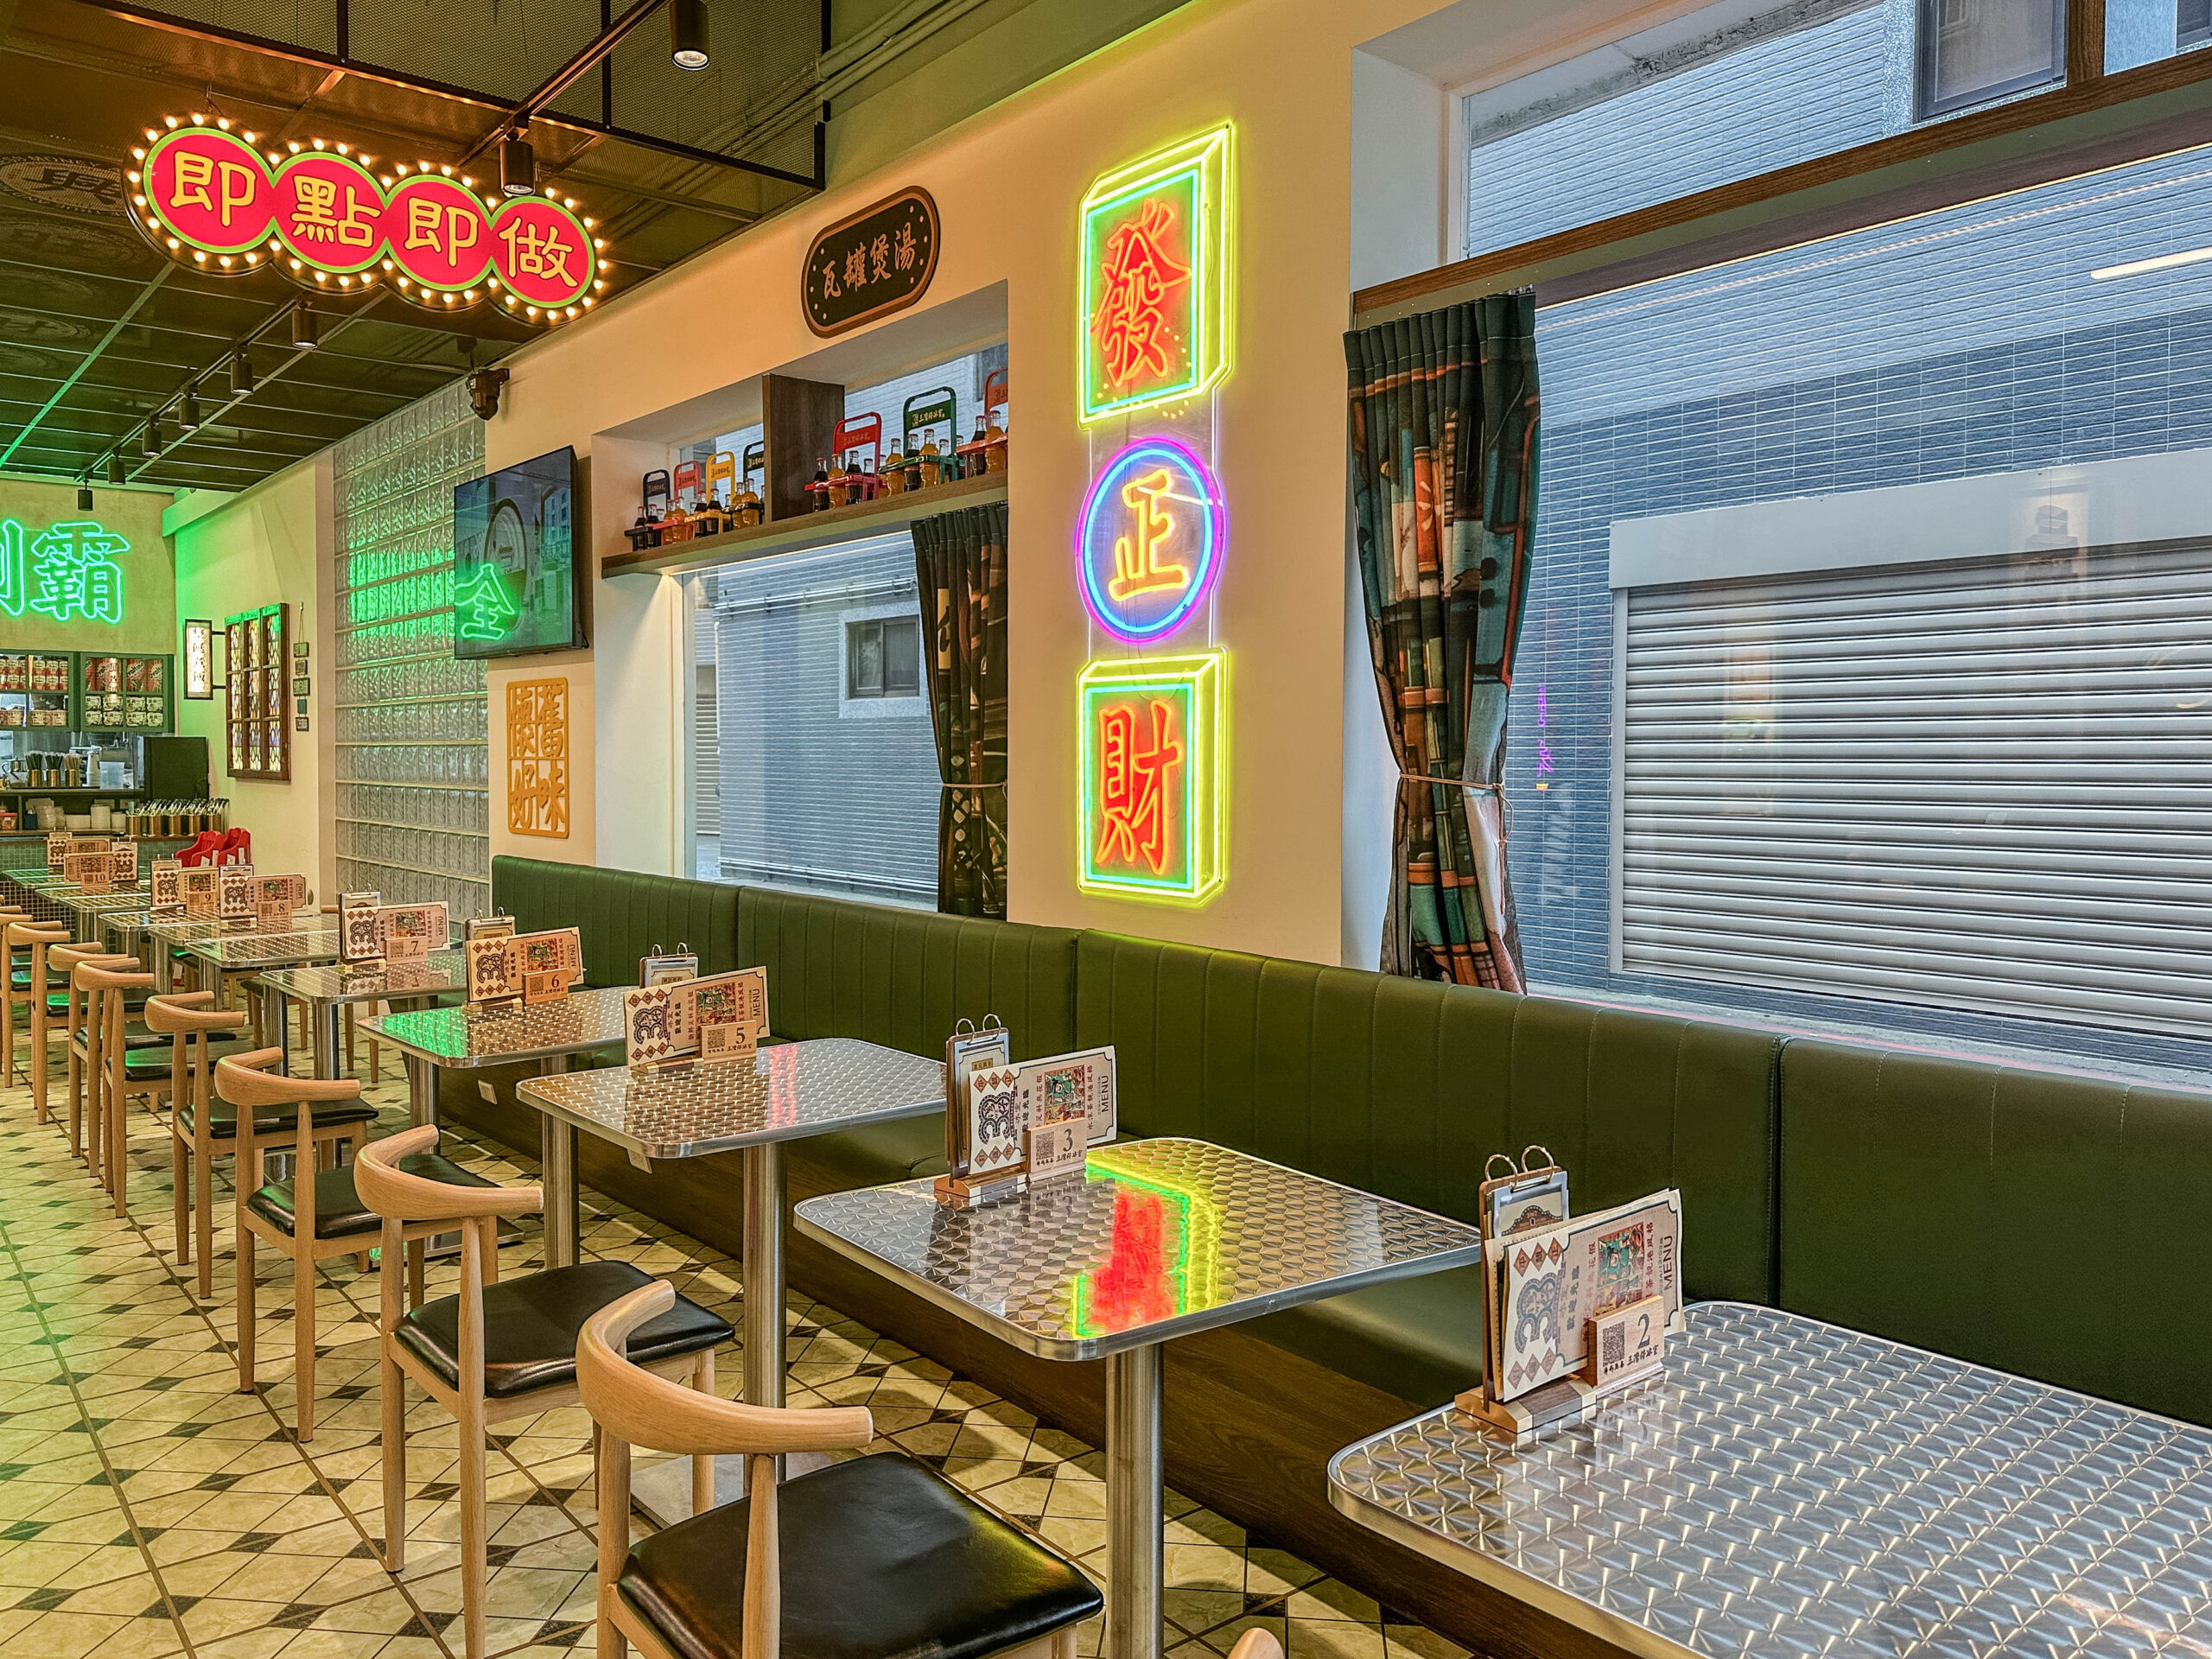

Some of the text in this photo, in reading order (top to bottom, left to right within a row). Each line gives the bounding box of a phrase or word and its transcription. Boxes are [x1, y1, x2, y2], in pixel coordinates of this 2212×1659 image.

[169, 150, 579, 288] 即點即做
[822, 221, 917, 300] 瓦罐煲湯
[1090, 196, 1192, 875] 發 正 財
[204, 893, 212, 902] 9
[277, 902, 285, 913] 8
[410, 940, 419, 953] 7
[551, 974, 560, 988] 6
[735, 1027, 745, 1045] 5
[1101, 1074, 1109, 1113] MENU
[1062, 1128, 1072, 1152] 3
[1663, 1235, 1674, 1292] MENU
[1637, 1313, 1650, 1350] 2
